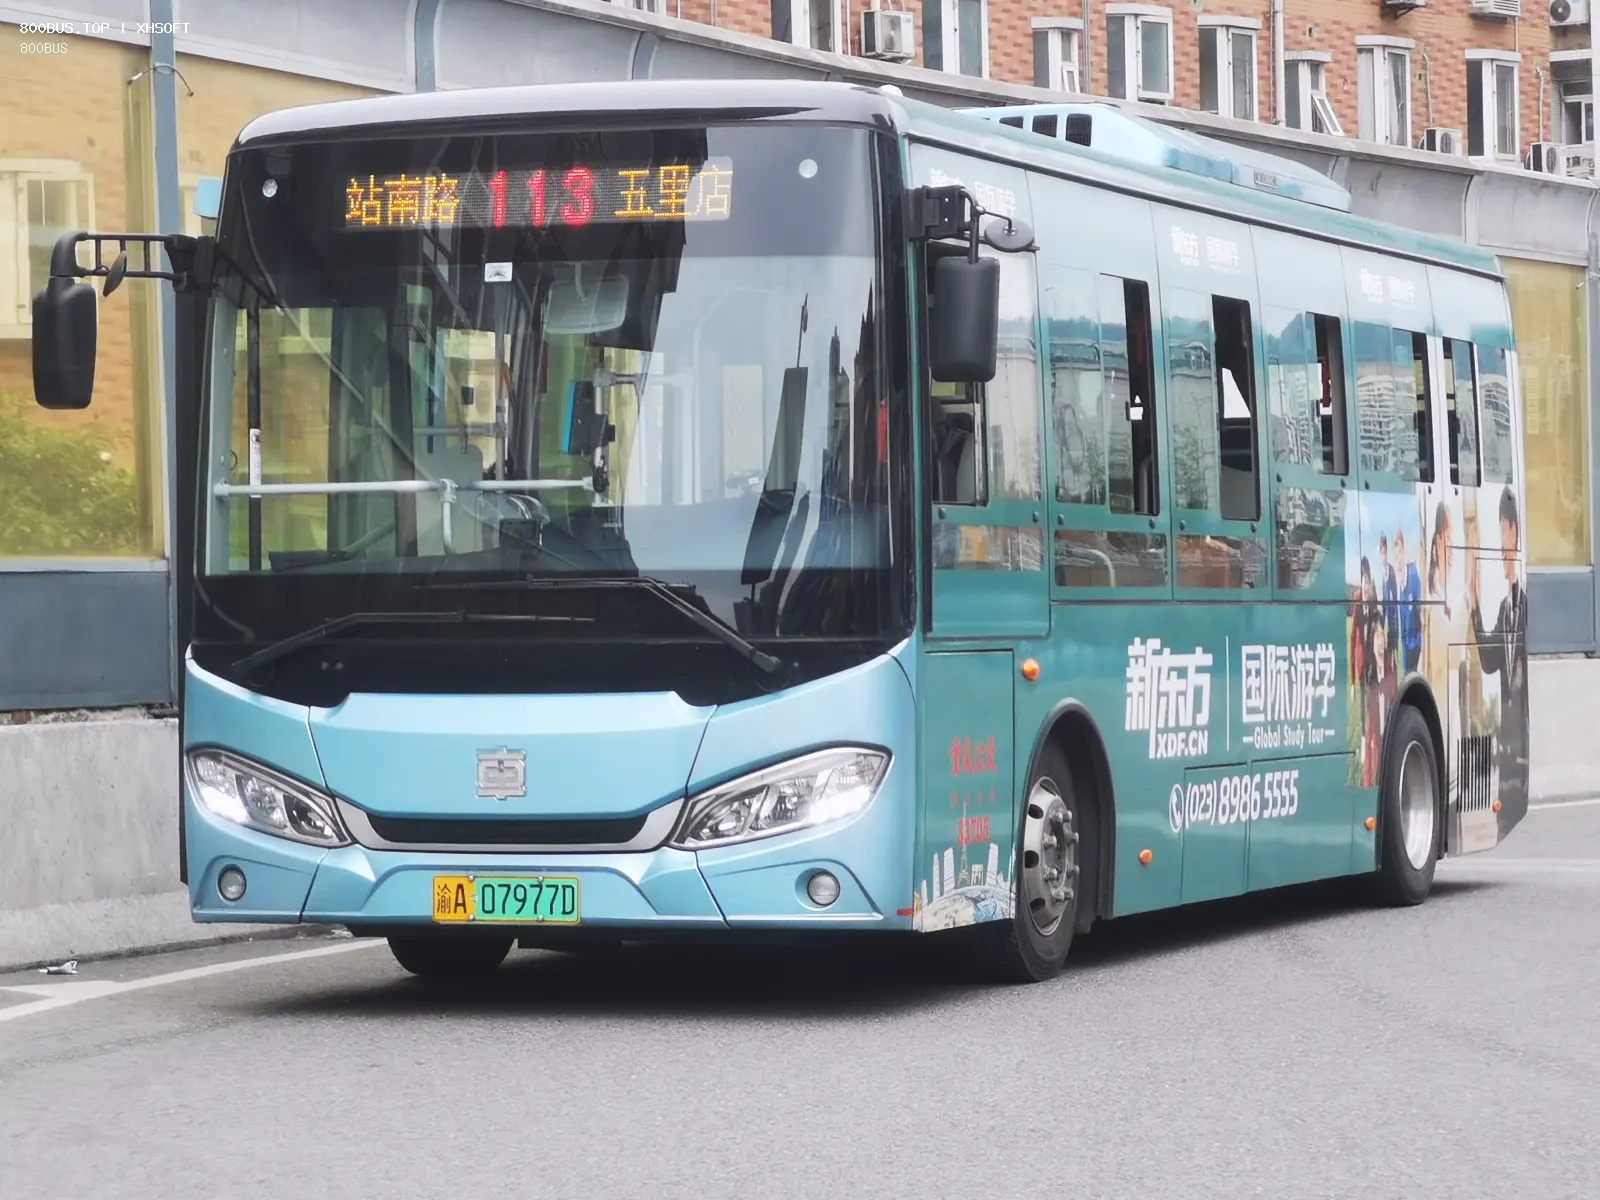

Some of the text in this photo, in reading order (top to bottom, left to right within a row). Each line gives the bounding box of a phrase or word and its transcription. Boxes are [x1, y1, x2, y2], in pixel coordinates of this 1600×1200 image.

[345, 164, 733, 227] 站南路 113 五里店
[1125, 637, 1336, 759] 新东方 国际游学
[1156, 730, 1209, 759] XDF.CN
[1254, 722, 1325, 750] Global Study Tour
